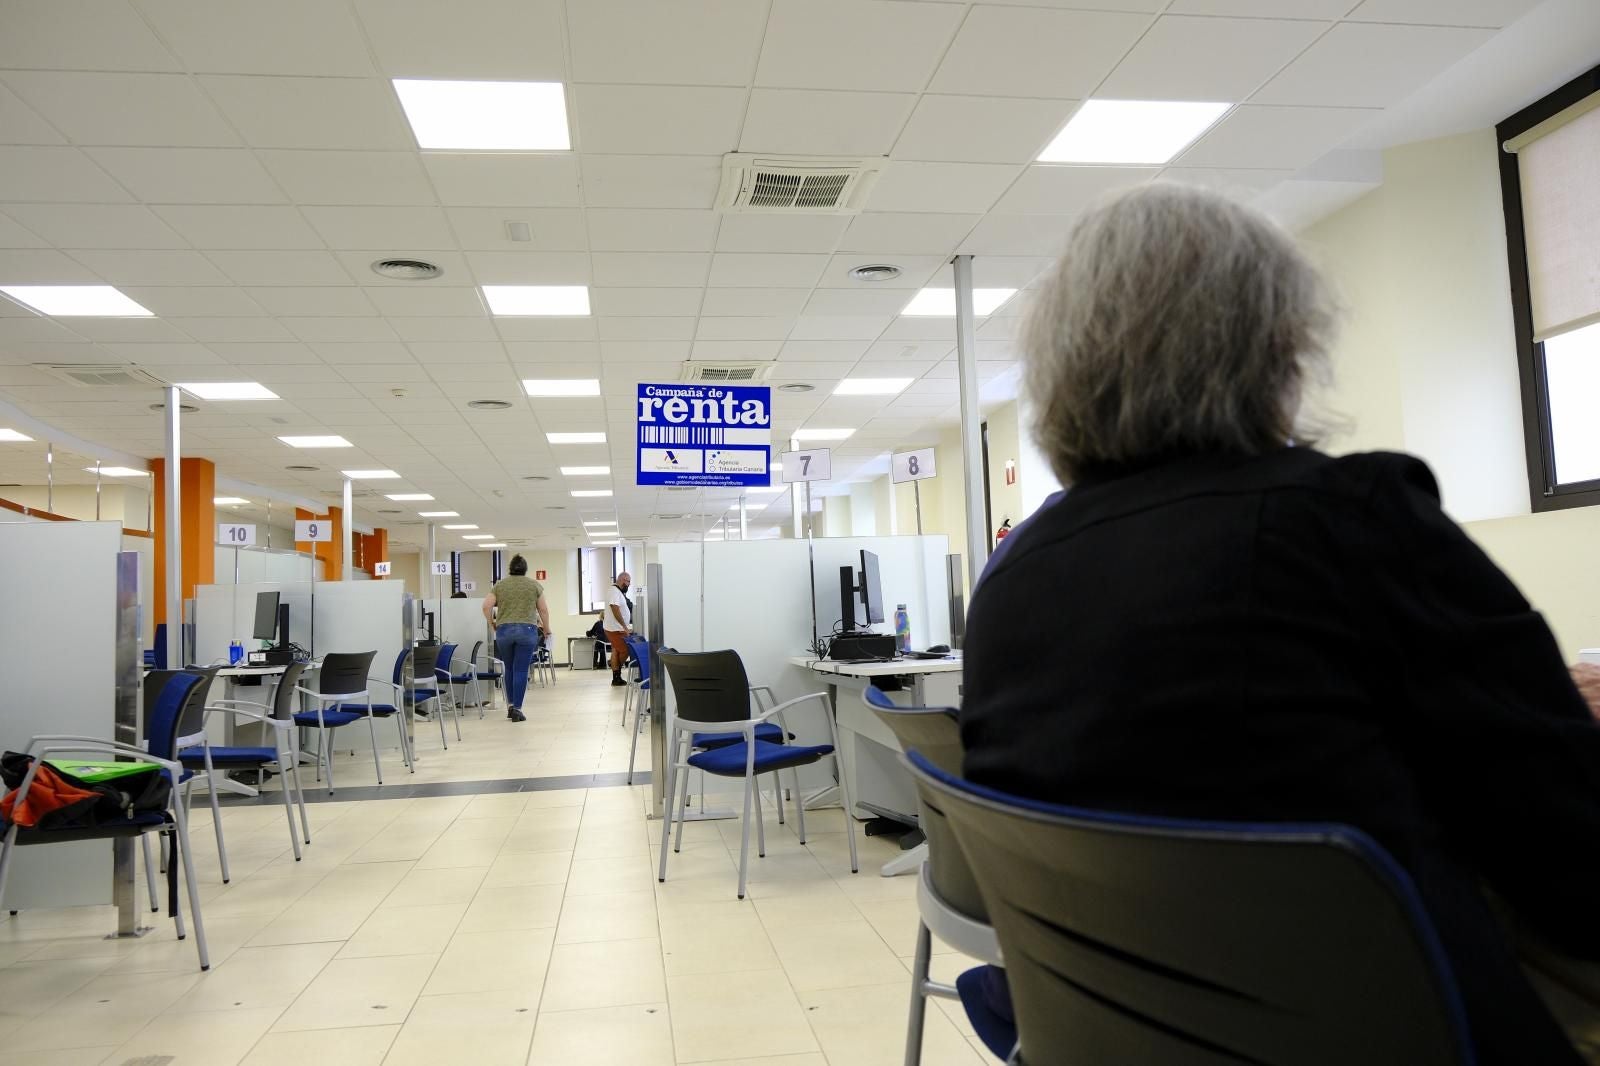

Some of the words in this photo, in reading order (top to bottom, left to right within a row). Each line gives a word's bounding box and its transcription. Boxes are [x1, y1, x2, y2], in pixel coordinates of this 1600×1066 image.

[645, 386, 705, 399] Campaña
[708, 388, 723, 398] de
[639, 391, 769, 425] renta
[800, 456, 811, 476] 7
[908, 455, 919, 475] 8
[229, 527, 247, 541] 10
[309, 524, 318, 538] 9
[379, 565, 387, 573] 14
[437, 564, 447, 573] 13
